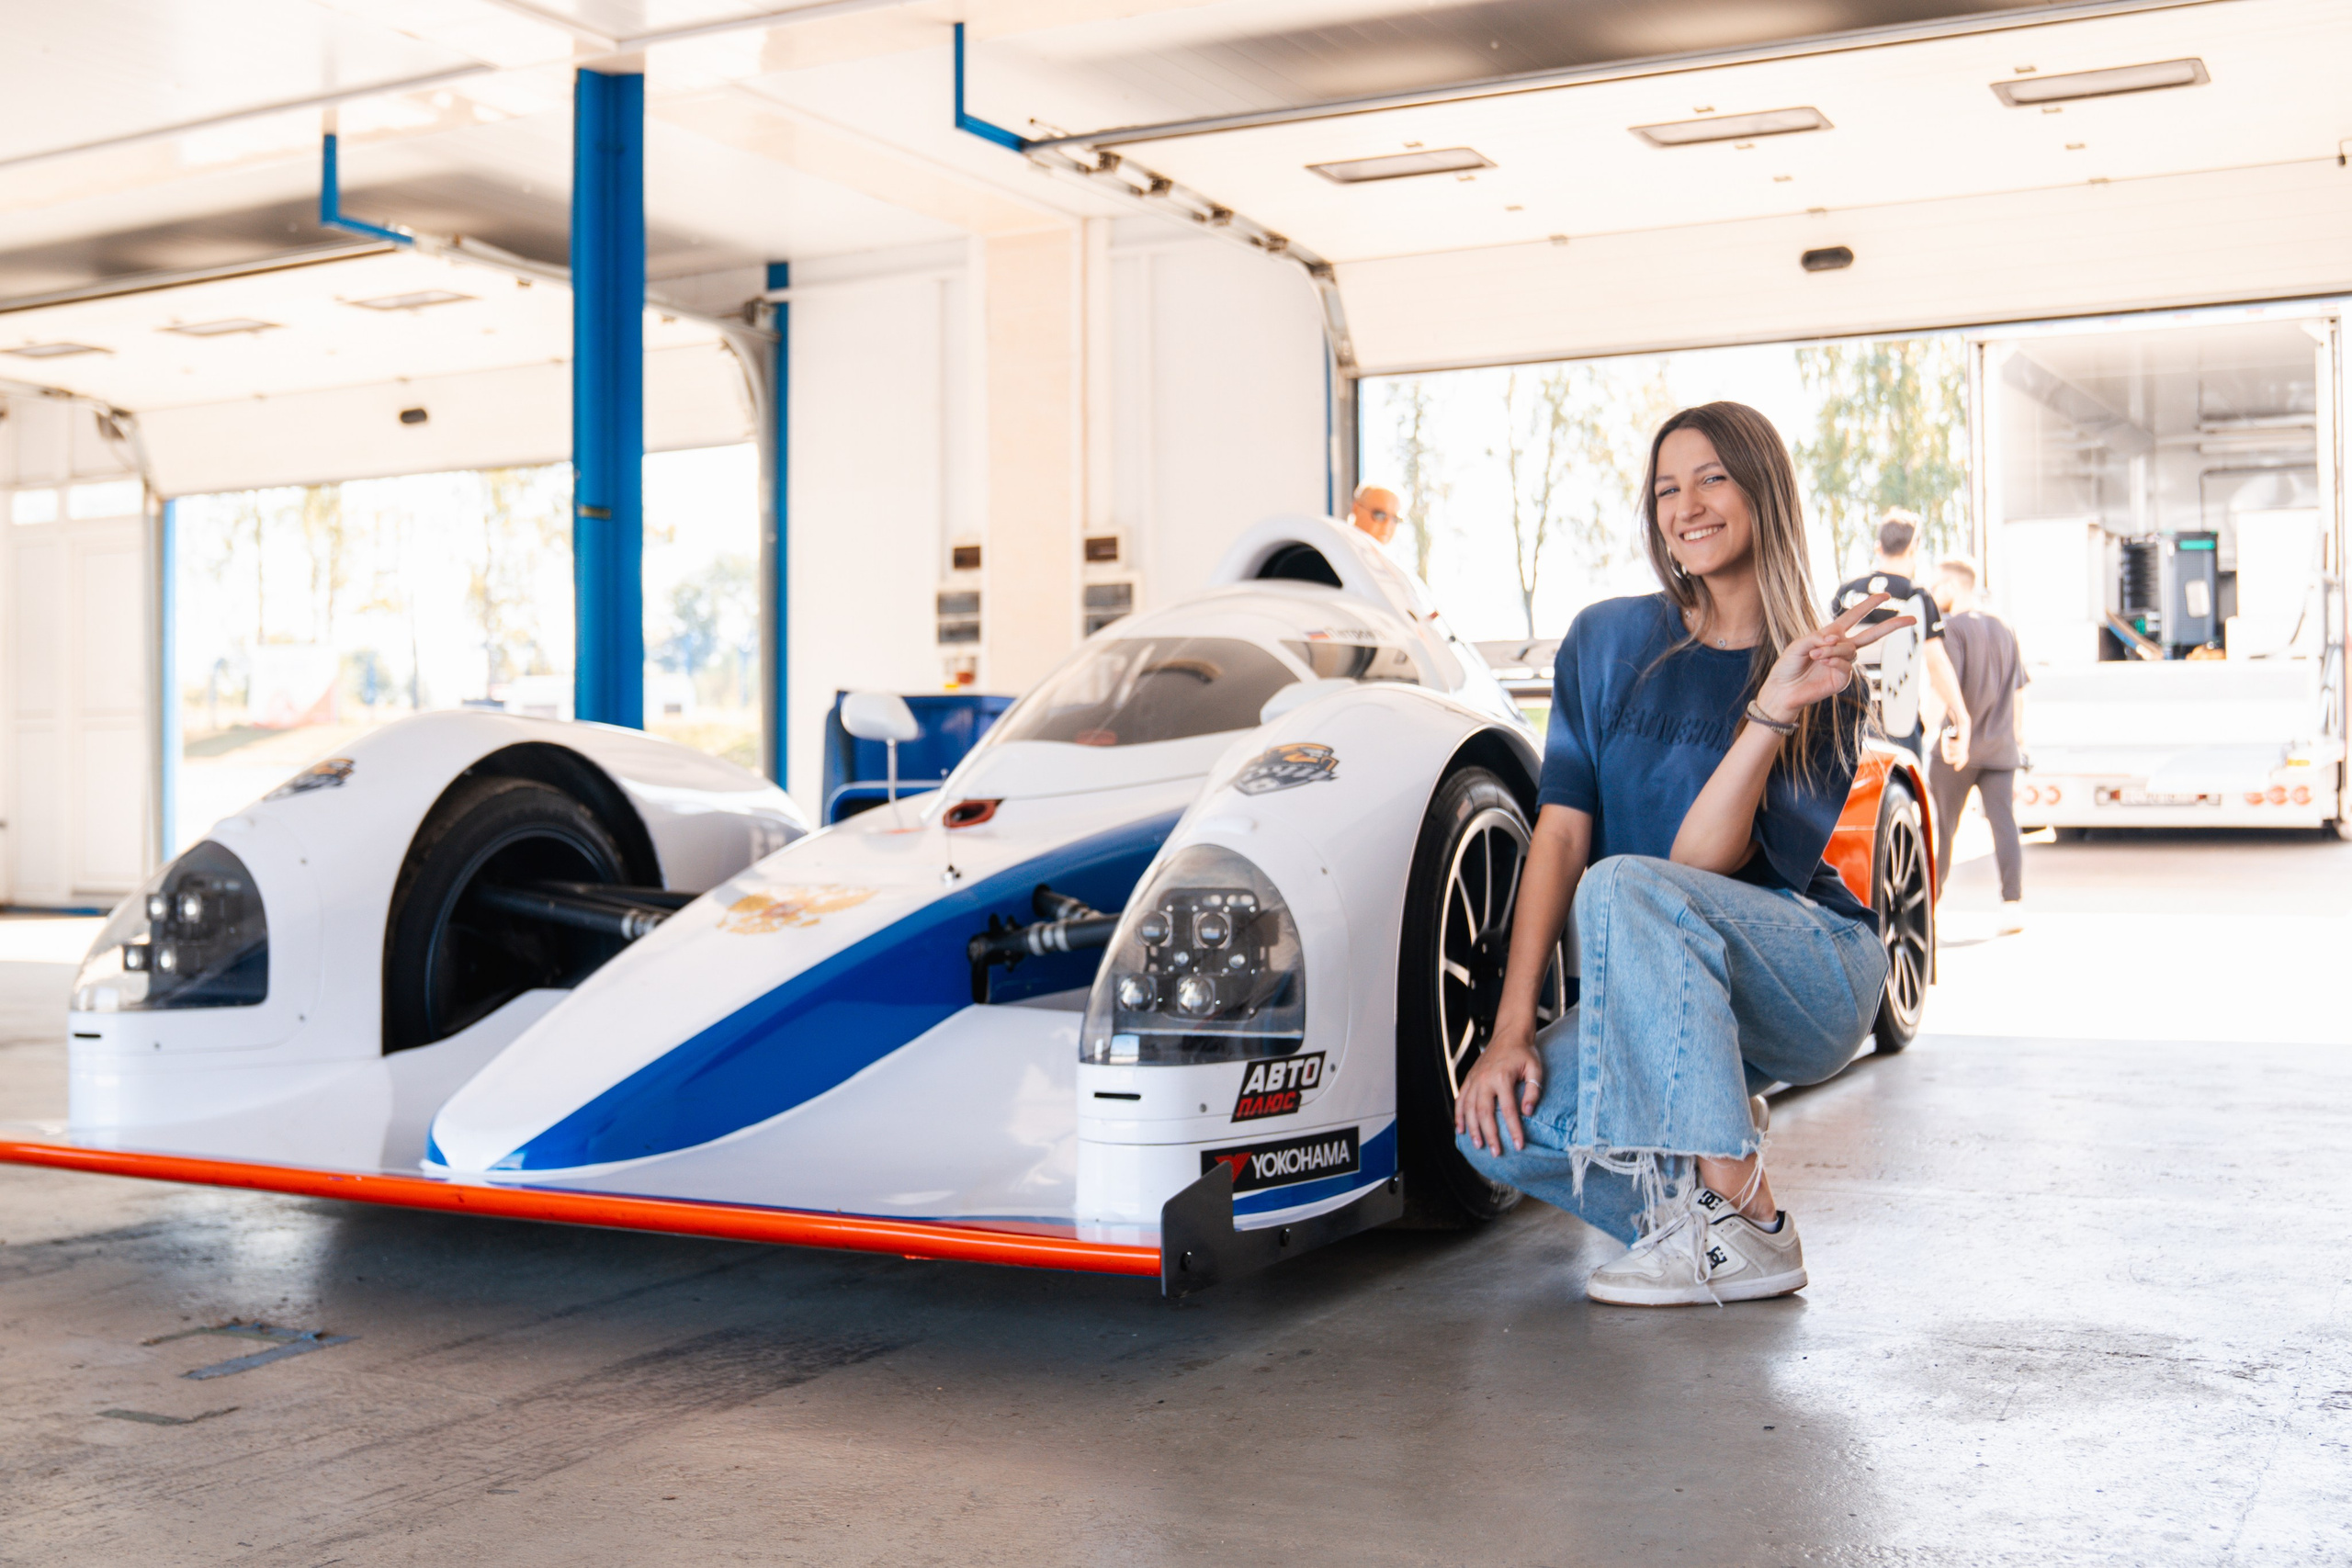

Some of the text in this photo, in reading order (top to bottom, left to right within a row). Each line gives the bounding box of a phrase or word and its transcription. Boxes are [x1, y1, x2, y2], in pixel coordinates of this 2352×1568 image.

[1242, 1056, 1321, 1094] АВТО
[1236, 1090, 1297, 1118] ПЛЮС
[1251, 1139, 1351, 1179] YOKOHAMA
